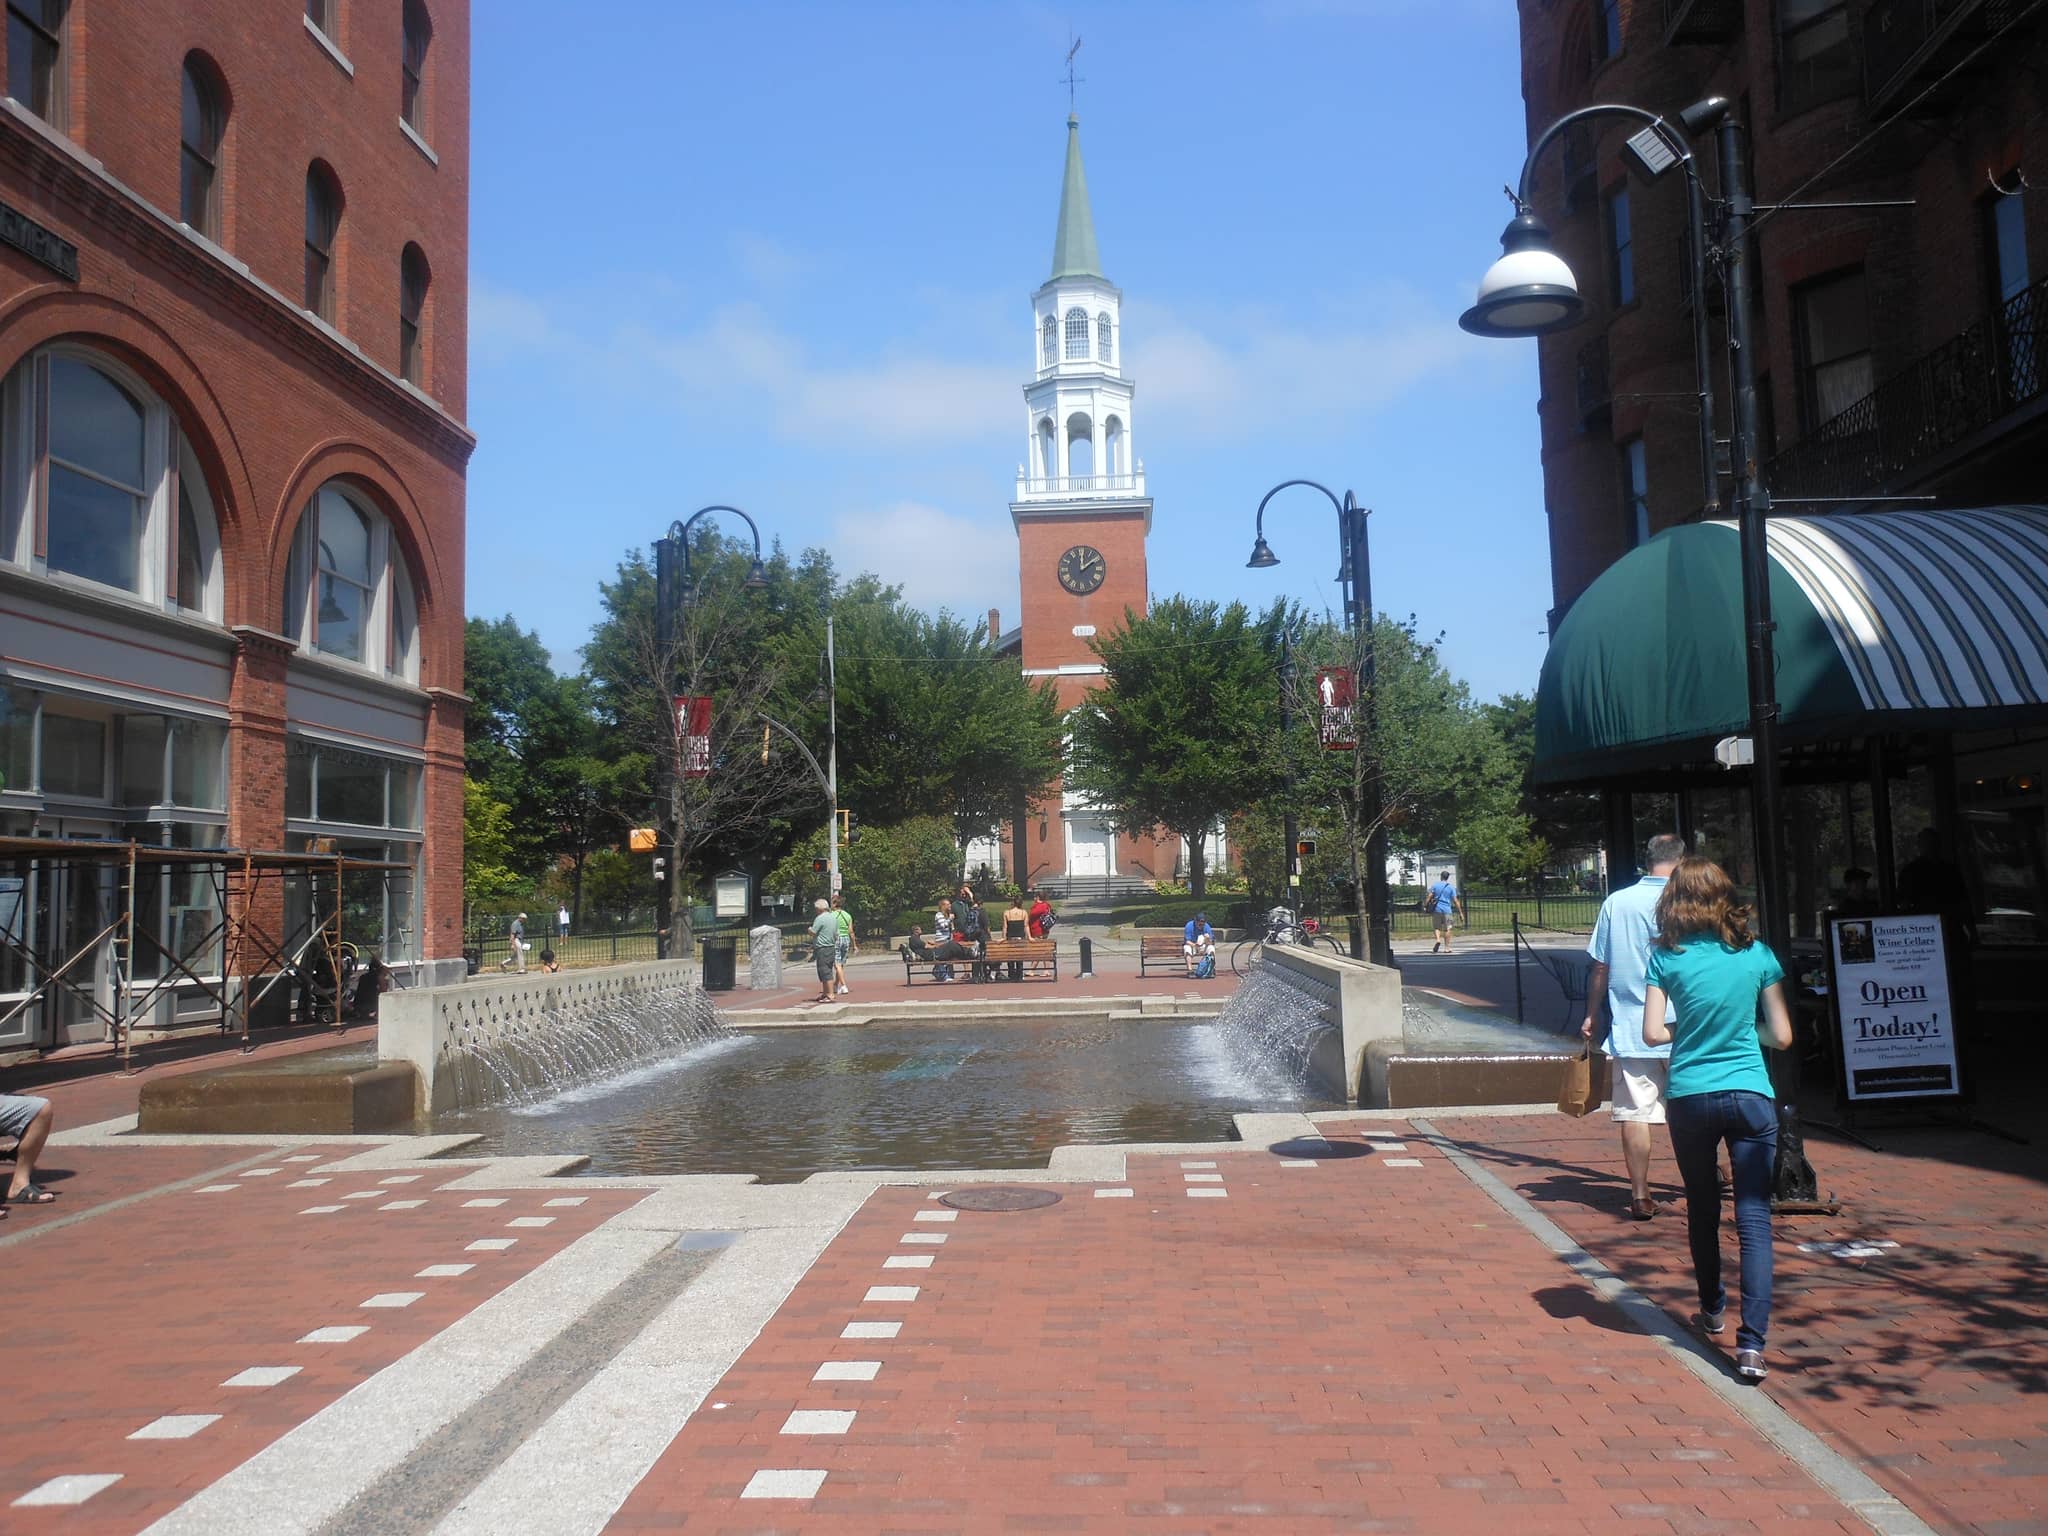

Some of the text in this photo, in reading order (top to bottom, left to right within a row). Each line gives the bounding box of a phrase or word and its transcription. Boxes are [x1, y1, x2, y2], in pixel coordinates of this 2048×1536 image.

[1874, 924, 1935, 936] Church Street
[1878, 937, 1935, 947] Wine Cellars
[1861, 980, 1927, 1008] Open
[1854, 1013, 1939, 1042] Today!
